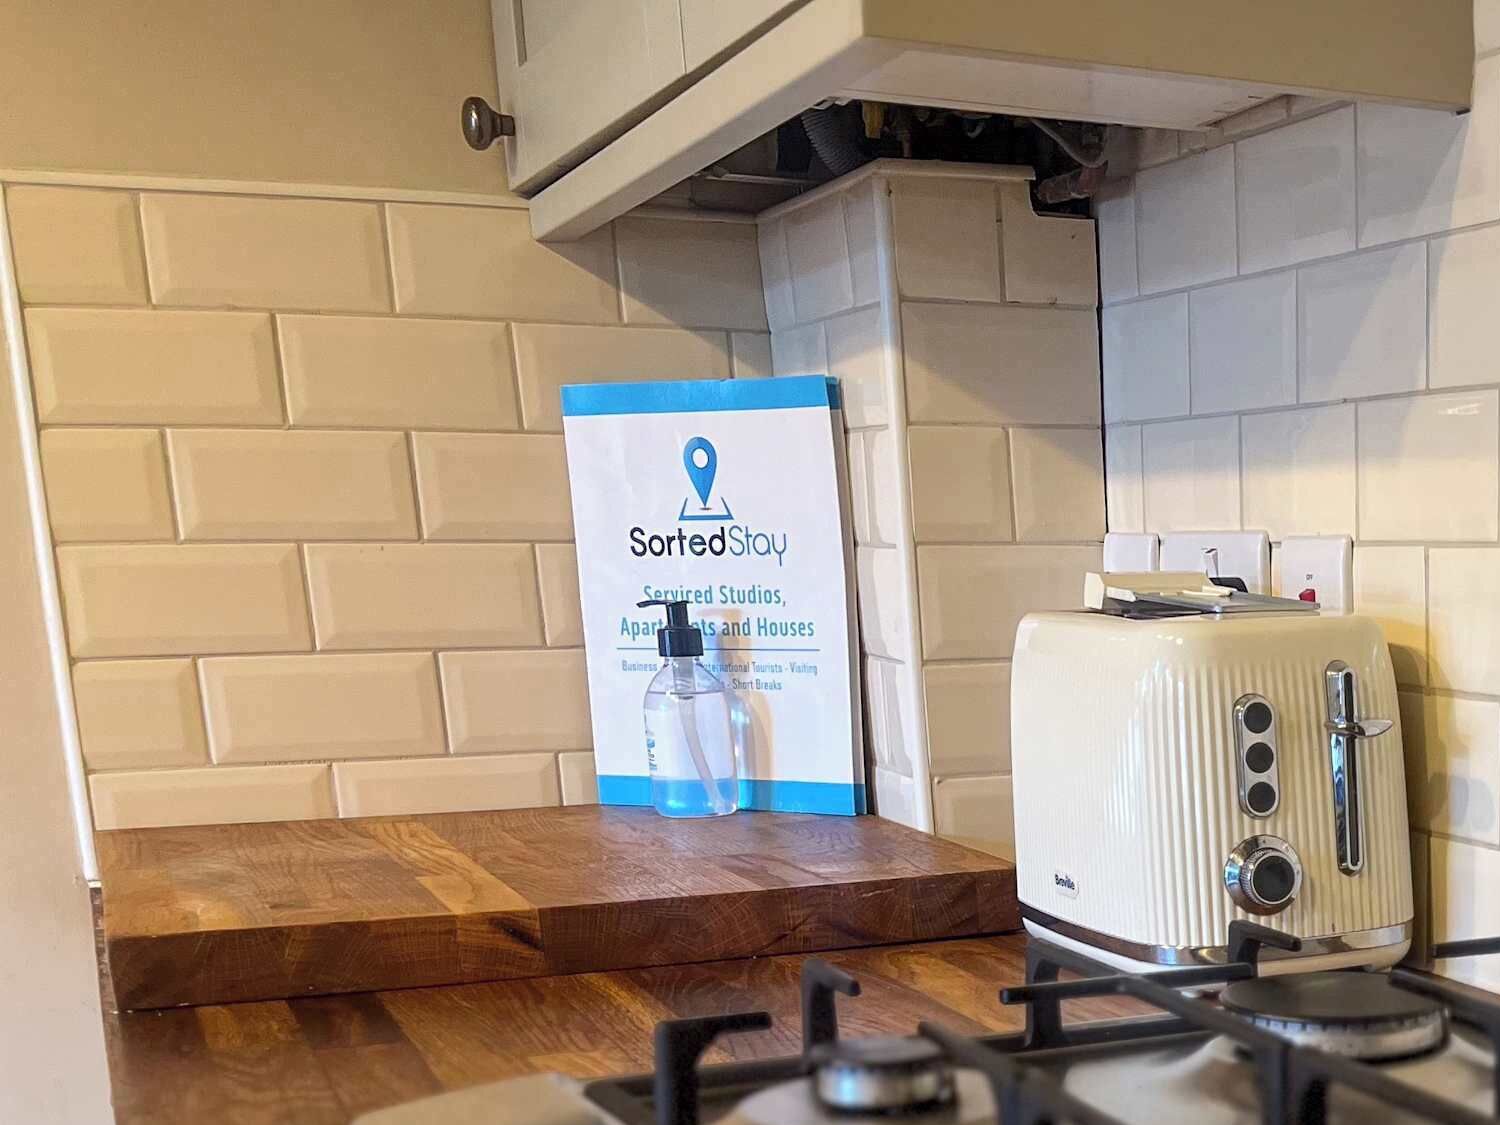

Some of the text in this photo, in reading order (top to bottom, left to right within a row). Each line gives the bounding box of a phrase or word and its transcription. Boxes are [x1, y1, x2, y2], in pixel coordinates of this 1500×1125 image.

[629, 525, 787, 567] SortedStay
[643, 585, 787, 607] Serviced Studios,
[620, 617, 815, 641] Apartts and Houses
[621, 659, 658, 672] Business
[703, 661, 750, 673] ternational
[751, 661, 783, 673] Tourists
[788, 661, 819, 676] Visiting
[732, 677, 754, 690] Short
[755, 677, 783, 691] Breaks
